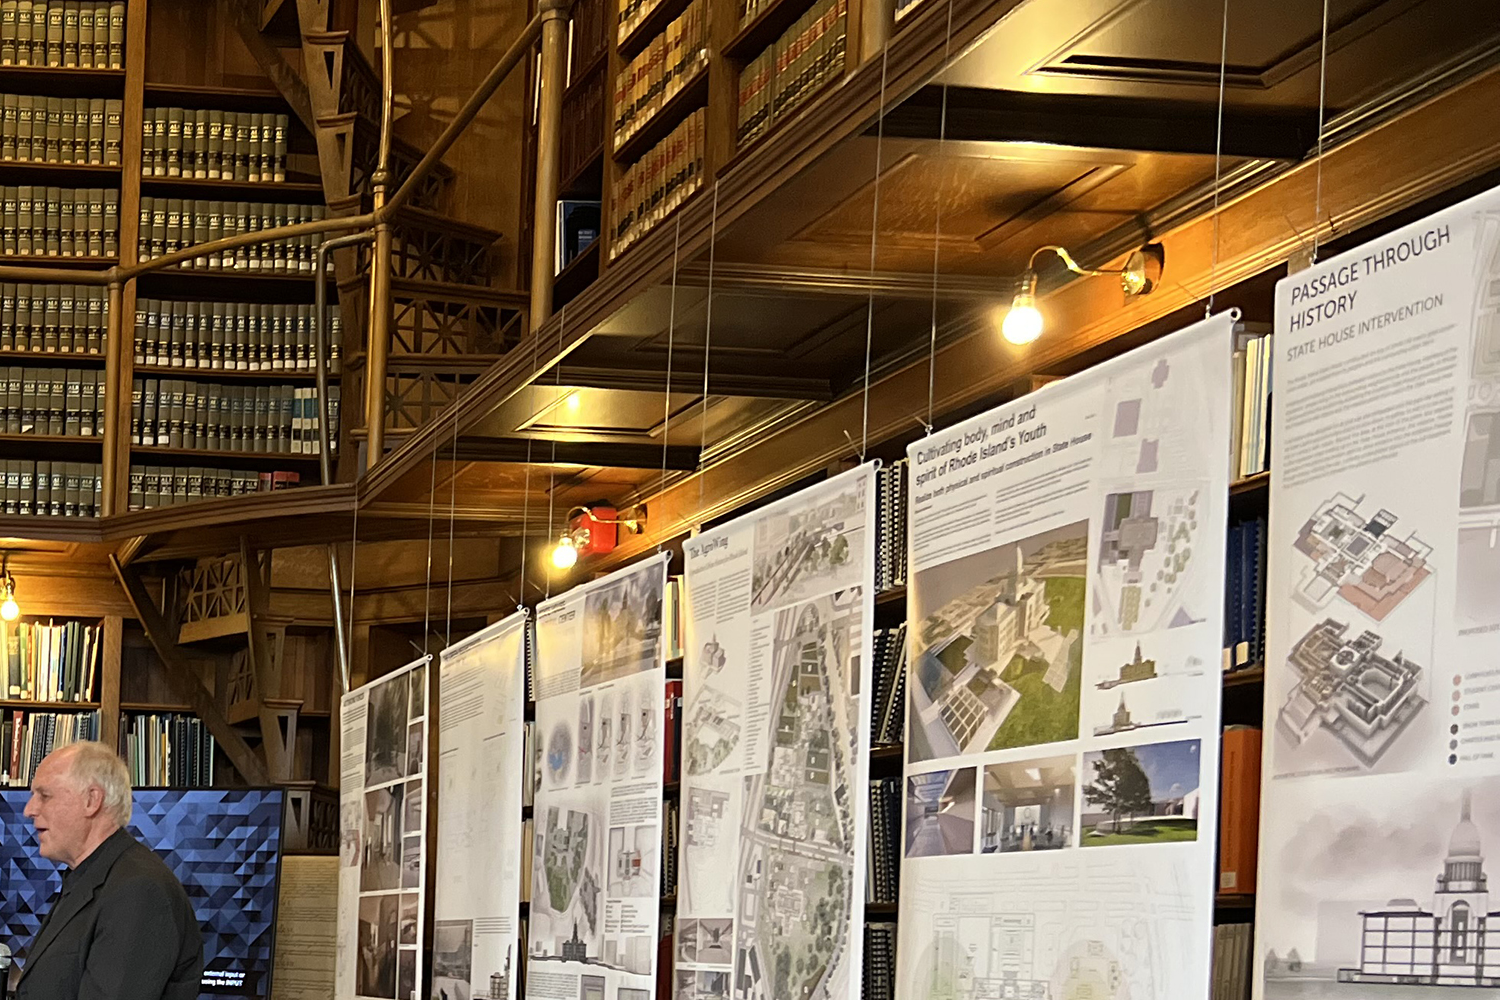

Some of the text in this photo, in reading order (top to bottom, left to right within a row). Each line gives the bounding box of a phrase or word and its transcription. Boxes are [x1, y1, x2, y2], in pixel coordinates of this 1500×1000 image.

[1291, 224, 1450, 306] PASSAGE THROUGH
[1287, 293, 1444, 362] STATE HOUSE INTERVENTION
[1290, 290, 1358, 332] HISTORY
[916, 464, 942, 487] spirit
[938, 460, 948, 475] of
[948, 452, 977, 473] Rhode
[1018, 422, 1047, 445] Youth
[917, 404, 1036, 465] Cultivating body, mind and
[1052, 440, 1069, 452] State
[1070, 432, 1092, 446] House
